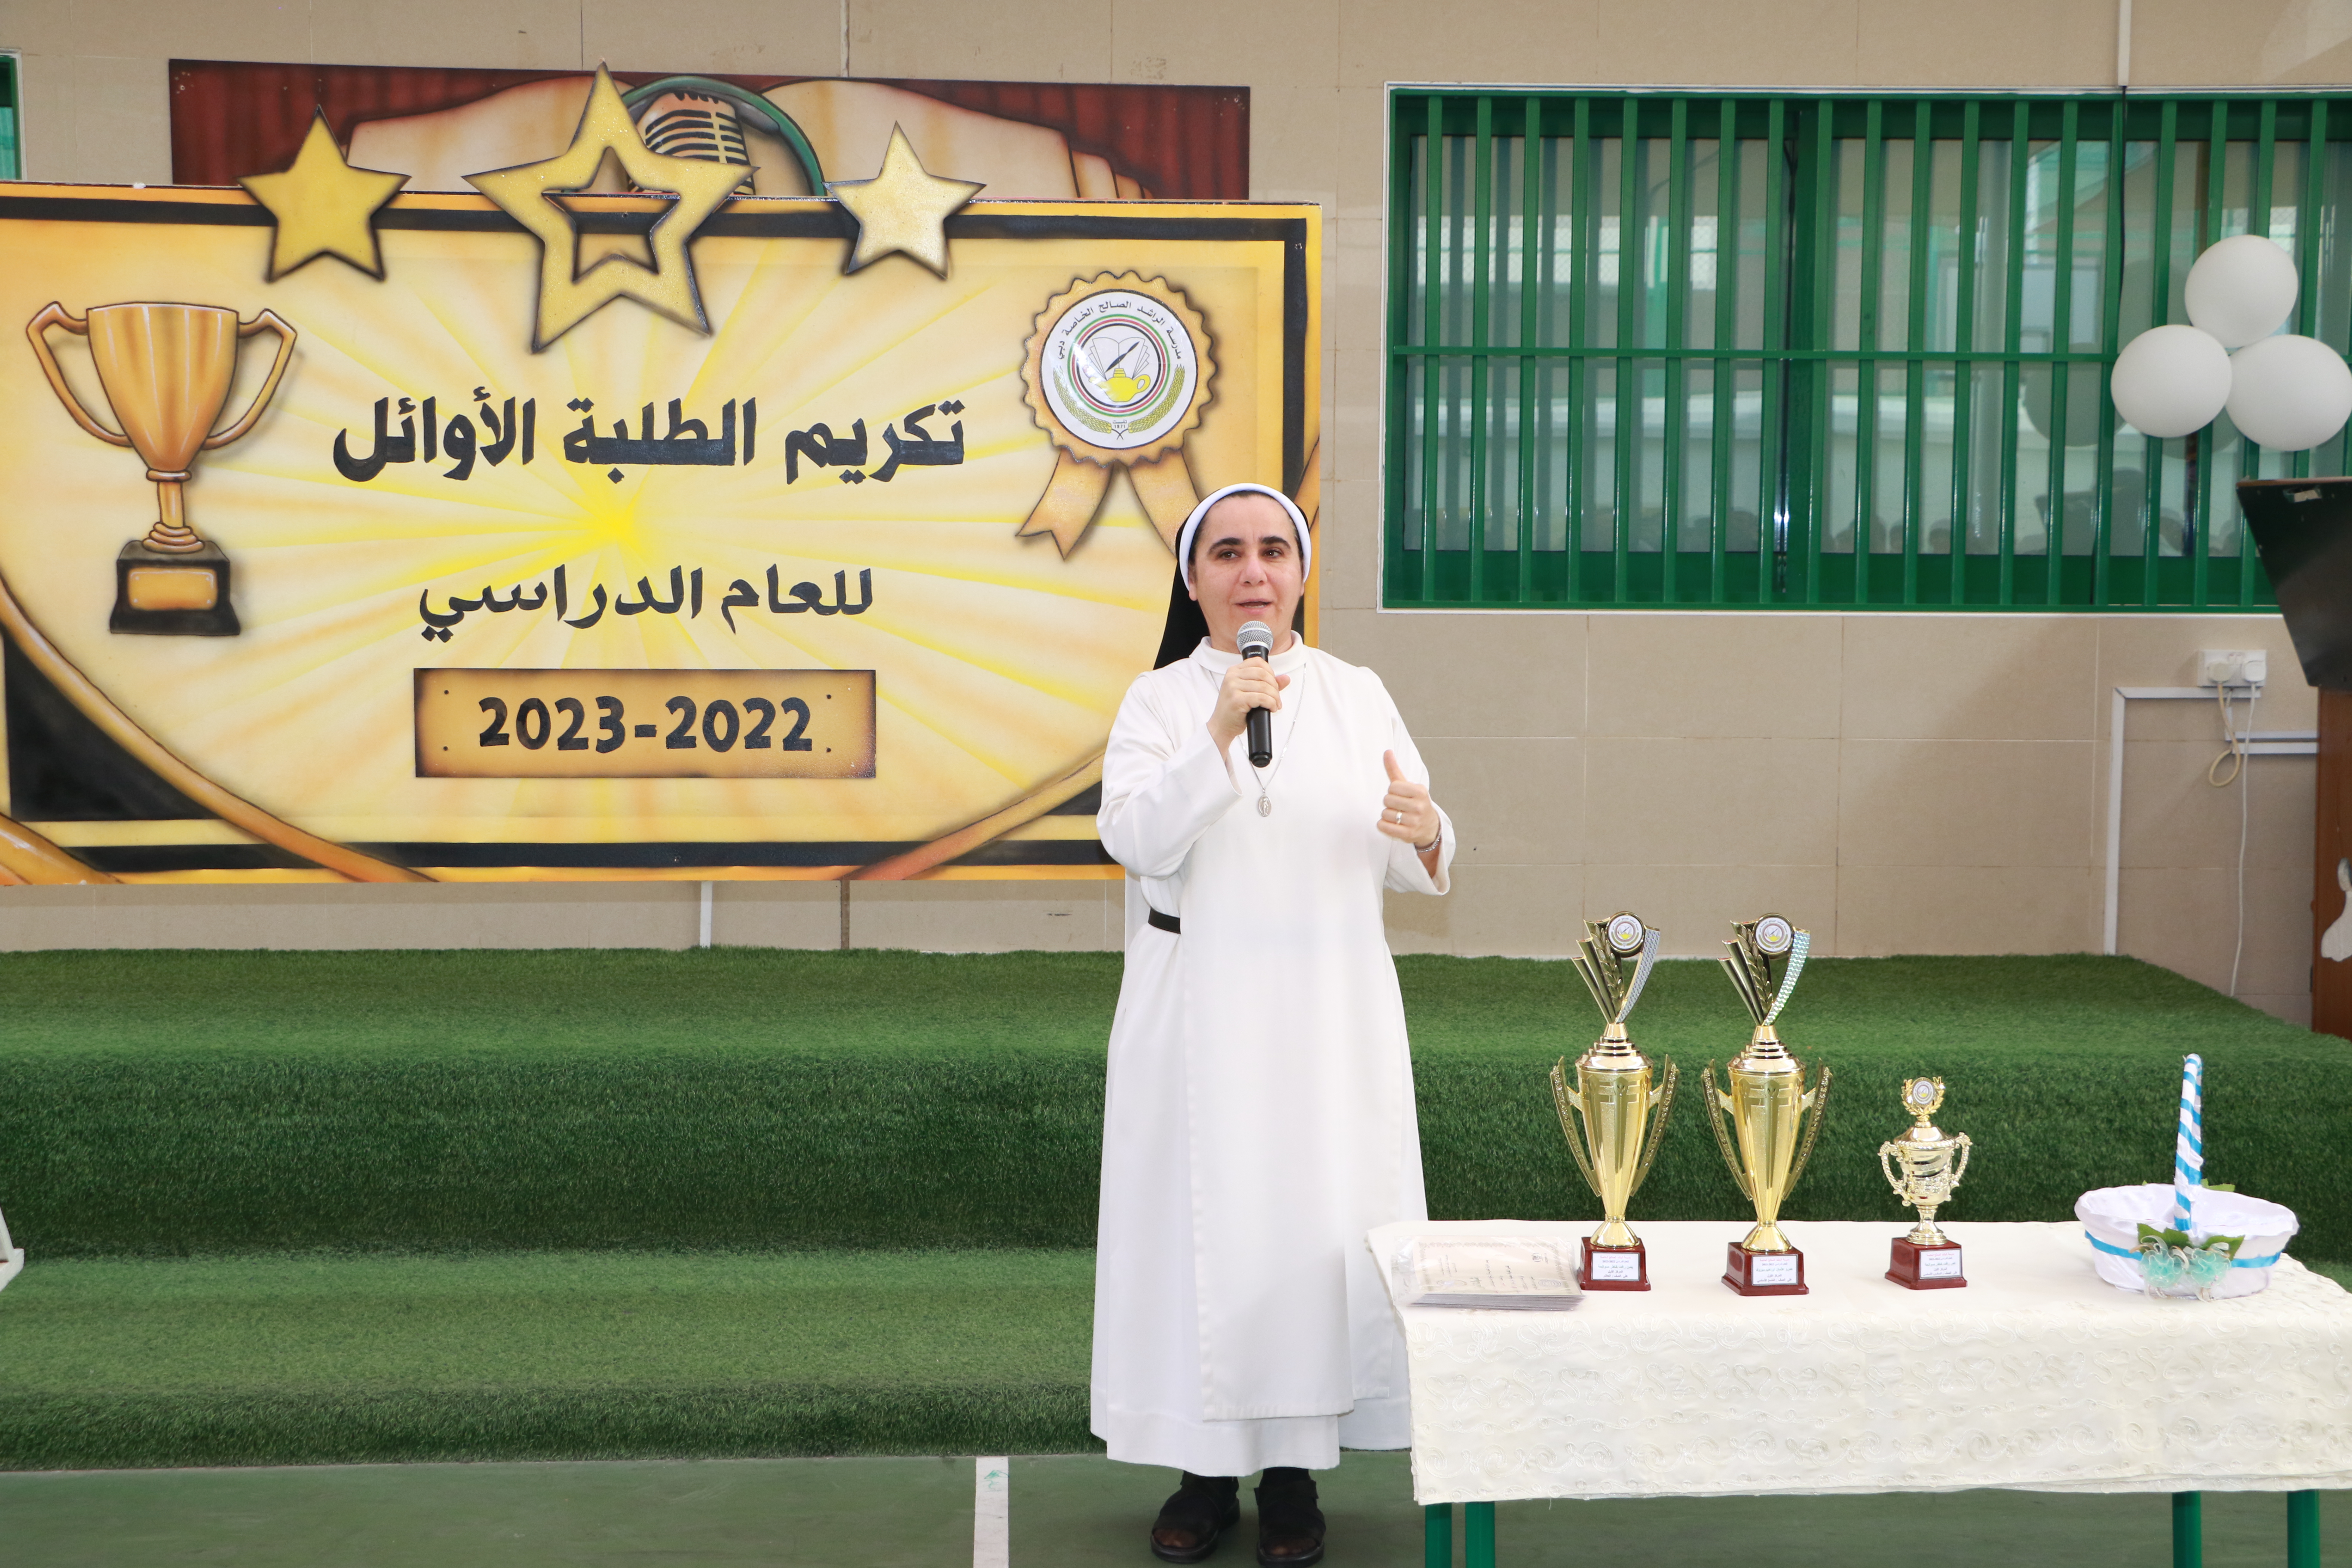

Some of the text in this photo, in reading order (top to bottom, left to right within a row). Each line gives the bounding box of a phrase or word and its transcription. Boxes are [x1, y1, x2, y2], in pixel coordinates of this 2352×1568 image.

[1062, 306, 1094, 336] الخاصة
[1098, 300, 1132, 312] الصالح
[1137, 306, 1166, 326] الراشد
[1166, 326, 1182, 360] مدرسة
[334, 387, 965, 484] تكريم الطلبة الأوائل
[420, 564, 872, 643] للعام الدراسي
[479, 696, 812, 753] 2023-2022
